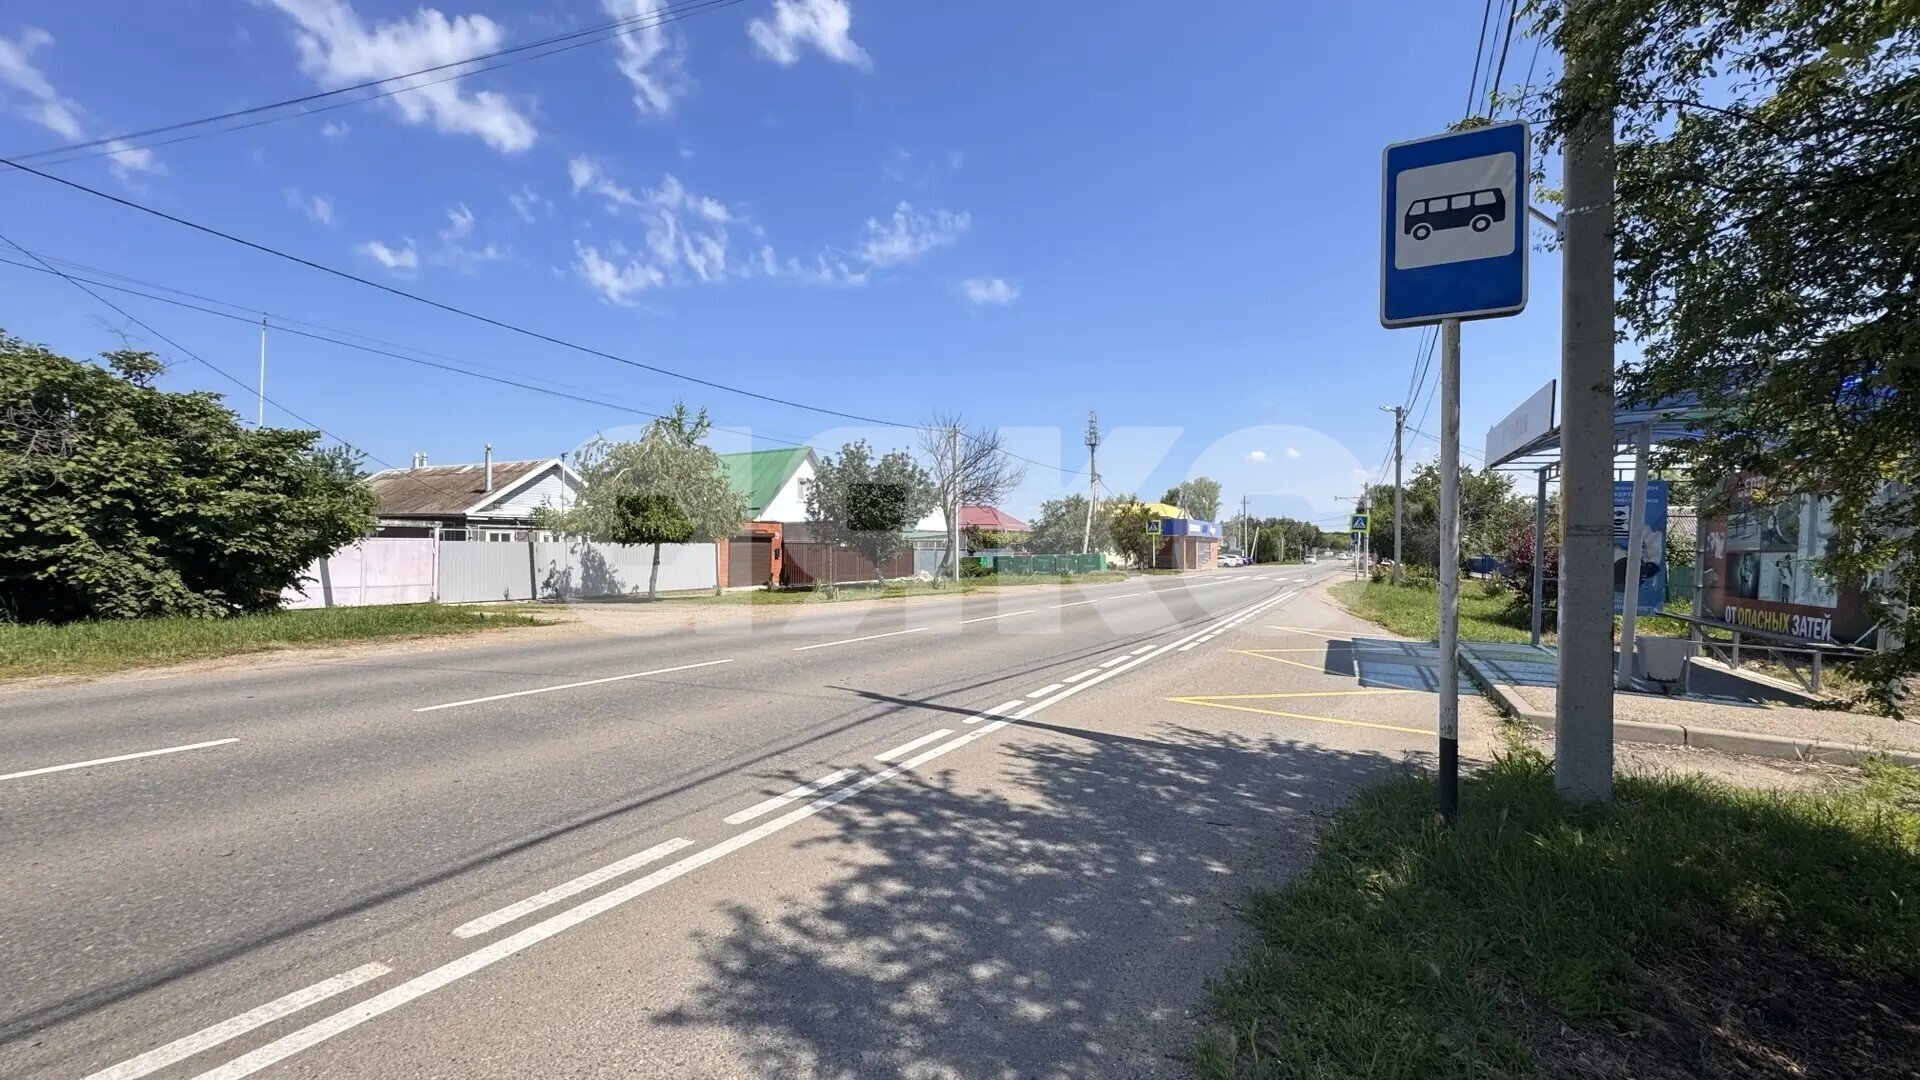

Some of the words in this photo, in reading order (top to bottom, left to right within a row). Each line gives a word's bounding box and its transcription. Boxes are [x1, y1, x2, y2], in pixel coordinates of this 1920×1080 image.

[1725, 605, 1737, 623] ОТ
[1737, 607, 1790, 634] ОПАСНЫХ
[1792, 611, 1832, 641] ЗАТЕЙ
